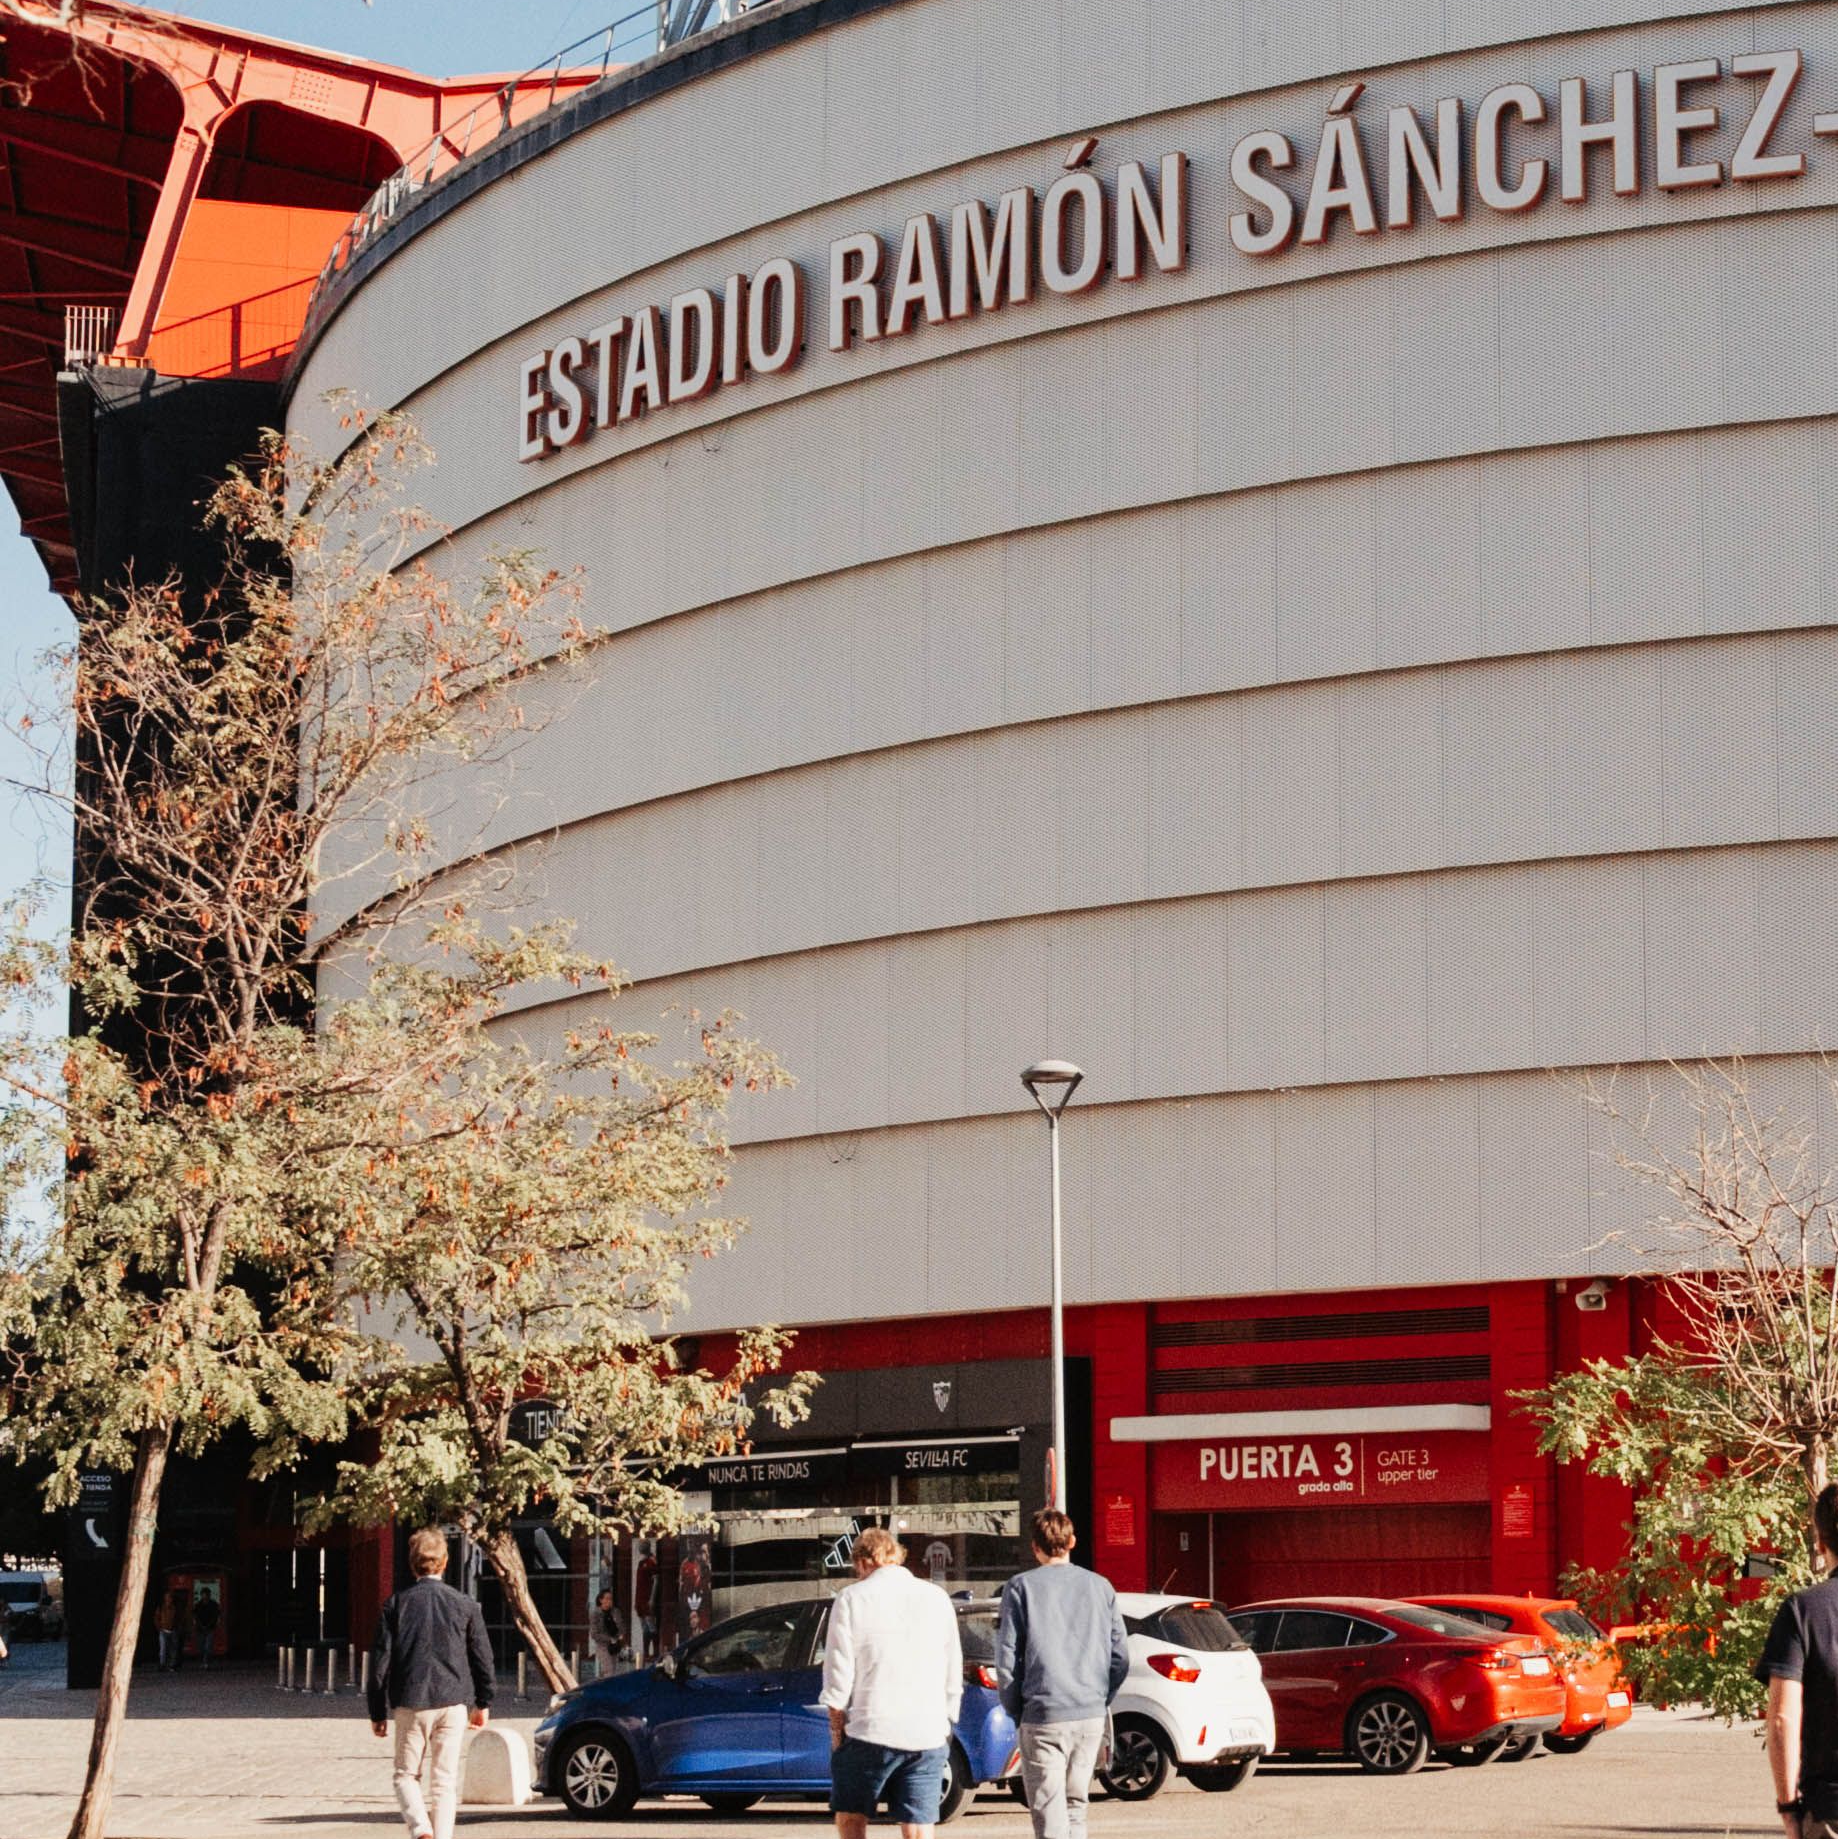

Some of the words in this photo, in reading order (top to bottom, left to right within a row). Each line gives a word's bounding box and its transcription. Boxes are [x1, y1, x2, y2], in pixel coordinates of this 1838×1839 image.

[518, 255, 801, 464] ESTADIO
[827, 138, 1190, 353] RAMÓN
[905, 1449, 950, 1469] SEVILLA
[952, 1448, 969, 1467] FC
[1200, 1444, 1320, 1481] PUERTA
[1333, 1441, 1354, 1477] 3
[1377, 1450, 1417, 1467] GATE
[1420, 1449, 1430, 1465] 3
[708, 1466, 748, 1483] NUNCA
[751, 1465, 765, 1481] TE
[768, 1462, 810, 1480] RINDAS
[1377, 1472, 1414, 1486] upper
[1417, 1468, 1439, 1480] tier
[1298, 1481, 1331, 1496] grada
[1332, 1480, 1354, 1492] alta
